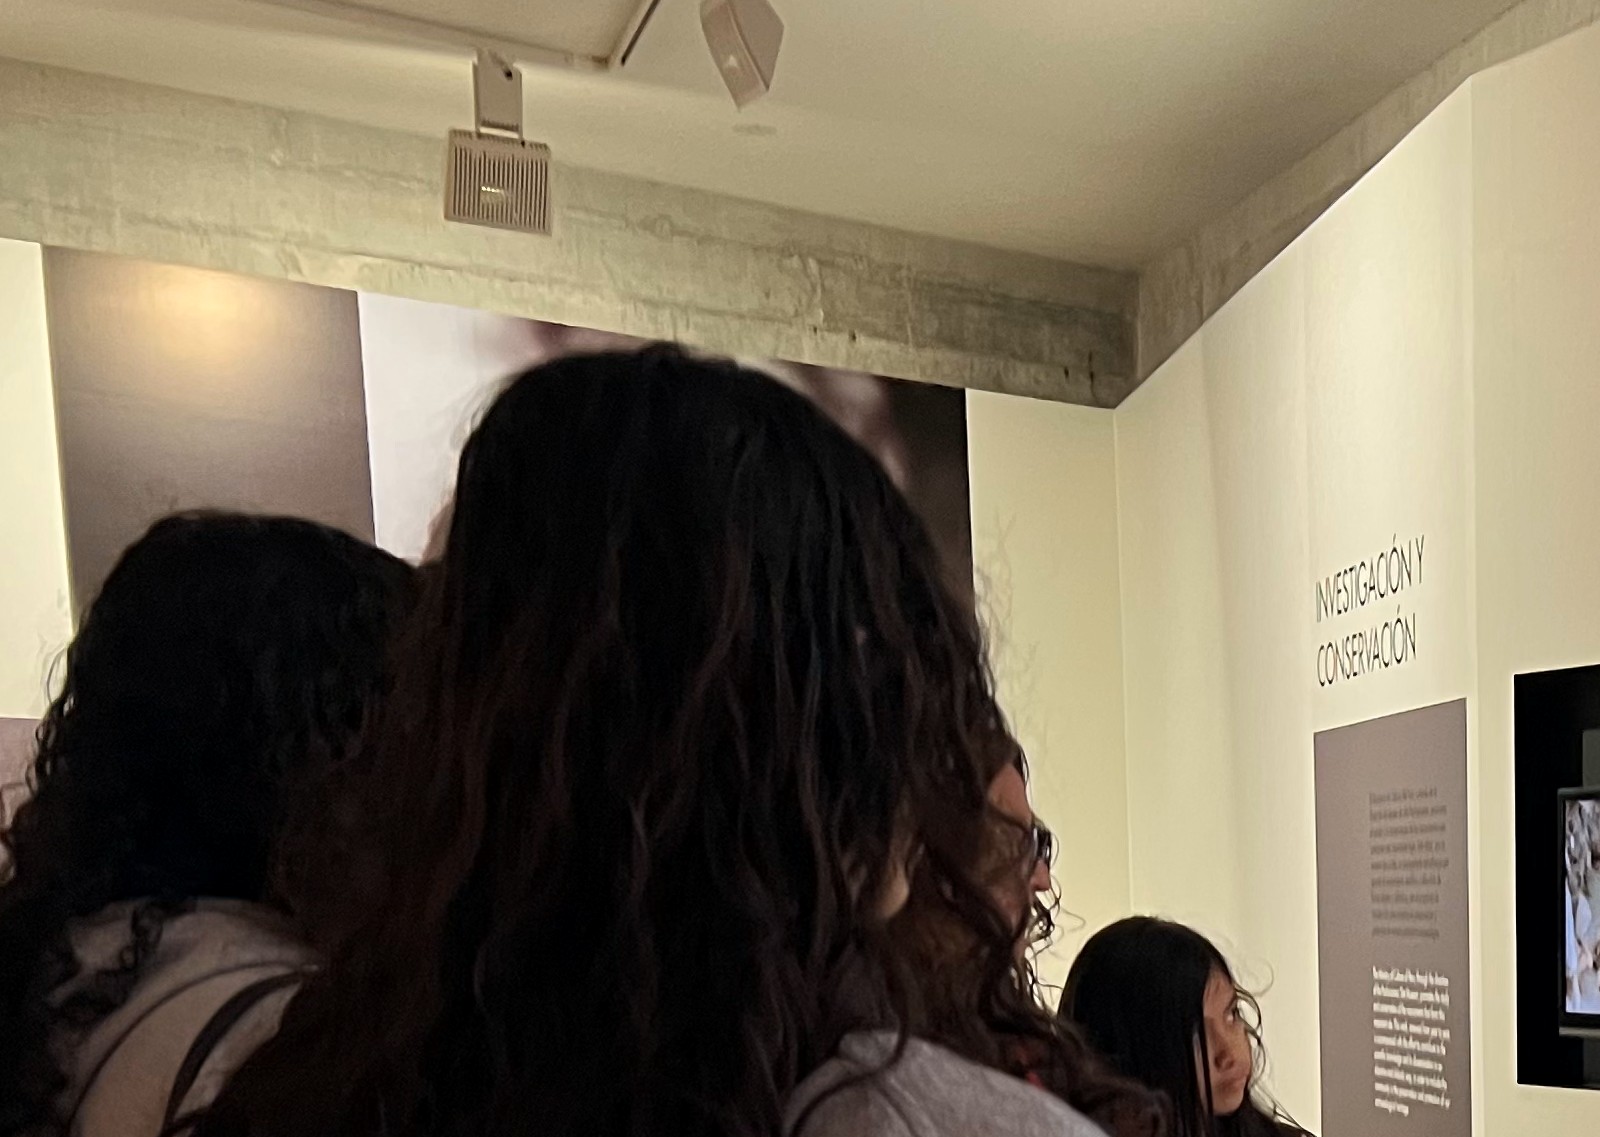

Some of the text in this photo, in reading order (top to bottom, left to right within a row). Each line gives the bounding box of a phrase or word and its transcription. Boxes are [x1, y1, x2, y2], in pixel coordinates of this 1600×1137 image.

[1315, 533, 1425, 623] INVESTIGACIÓN Y
[1316, 604, 1417, 687] CONSERVACIÓN
